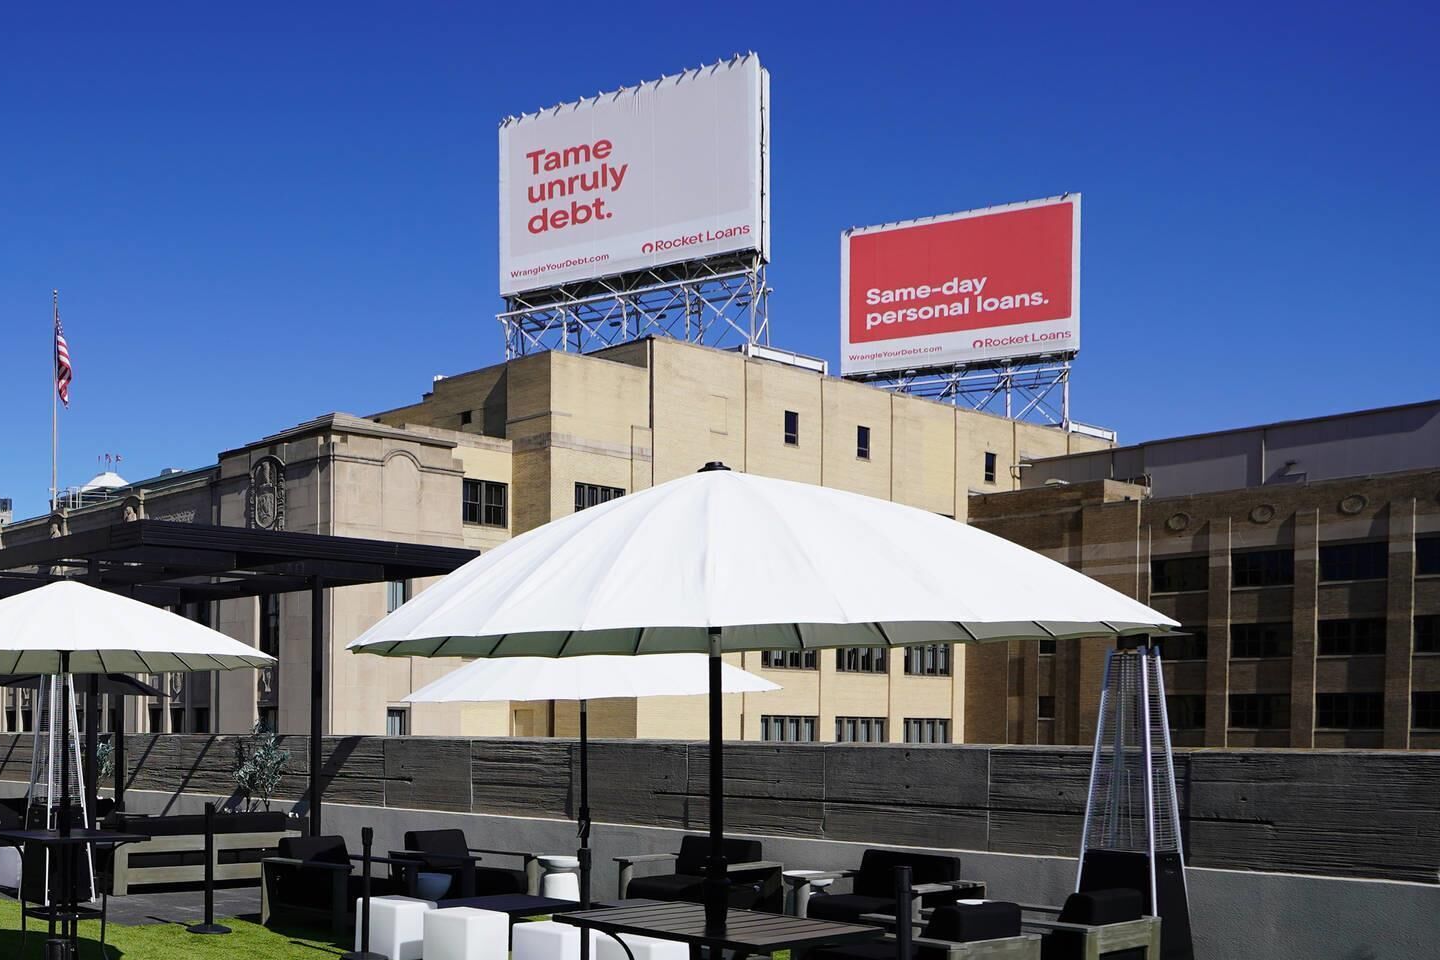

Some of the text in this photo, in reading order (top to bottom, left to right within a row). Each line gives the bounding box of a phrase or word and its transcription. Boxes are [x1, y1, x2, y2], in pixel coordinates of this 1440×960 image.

[526, 139, 613, 175] Tame
[527, 163, 629, 204] unruly
[527, 198, 613, 234] debt.
[655, 224, 750, 252] Rocket Loans
[510, 253, 610, 279] WrangleYourDebt.com
[866, 277, 988, 306] Same-day
[866, 291, 1049, 330] personal loans.
[848, 345, 943, 362] WrangleYourDebt.com
[985, 330, 1072, 348] Rocket Loans
